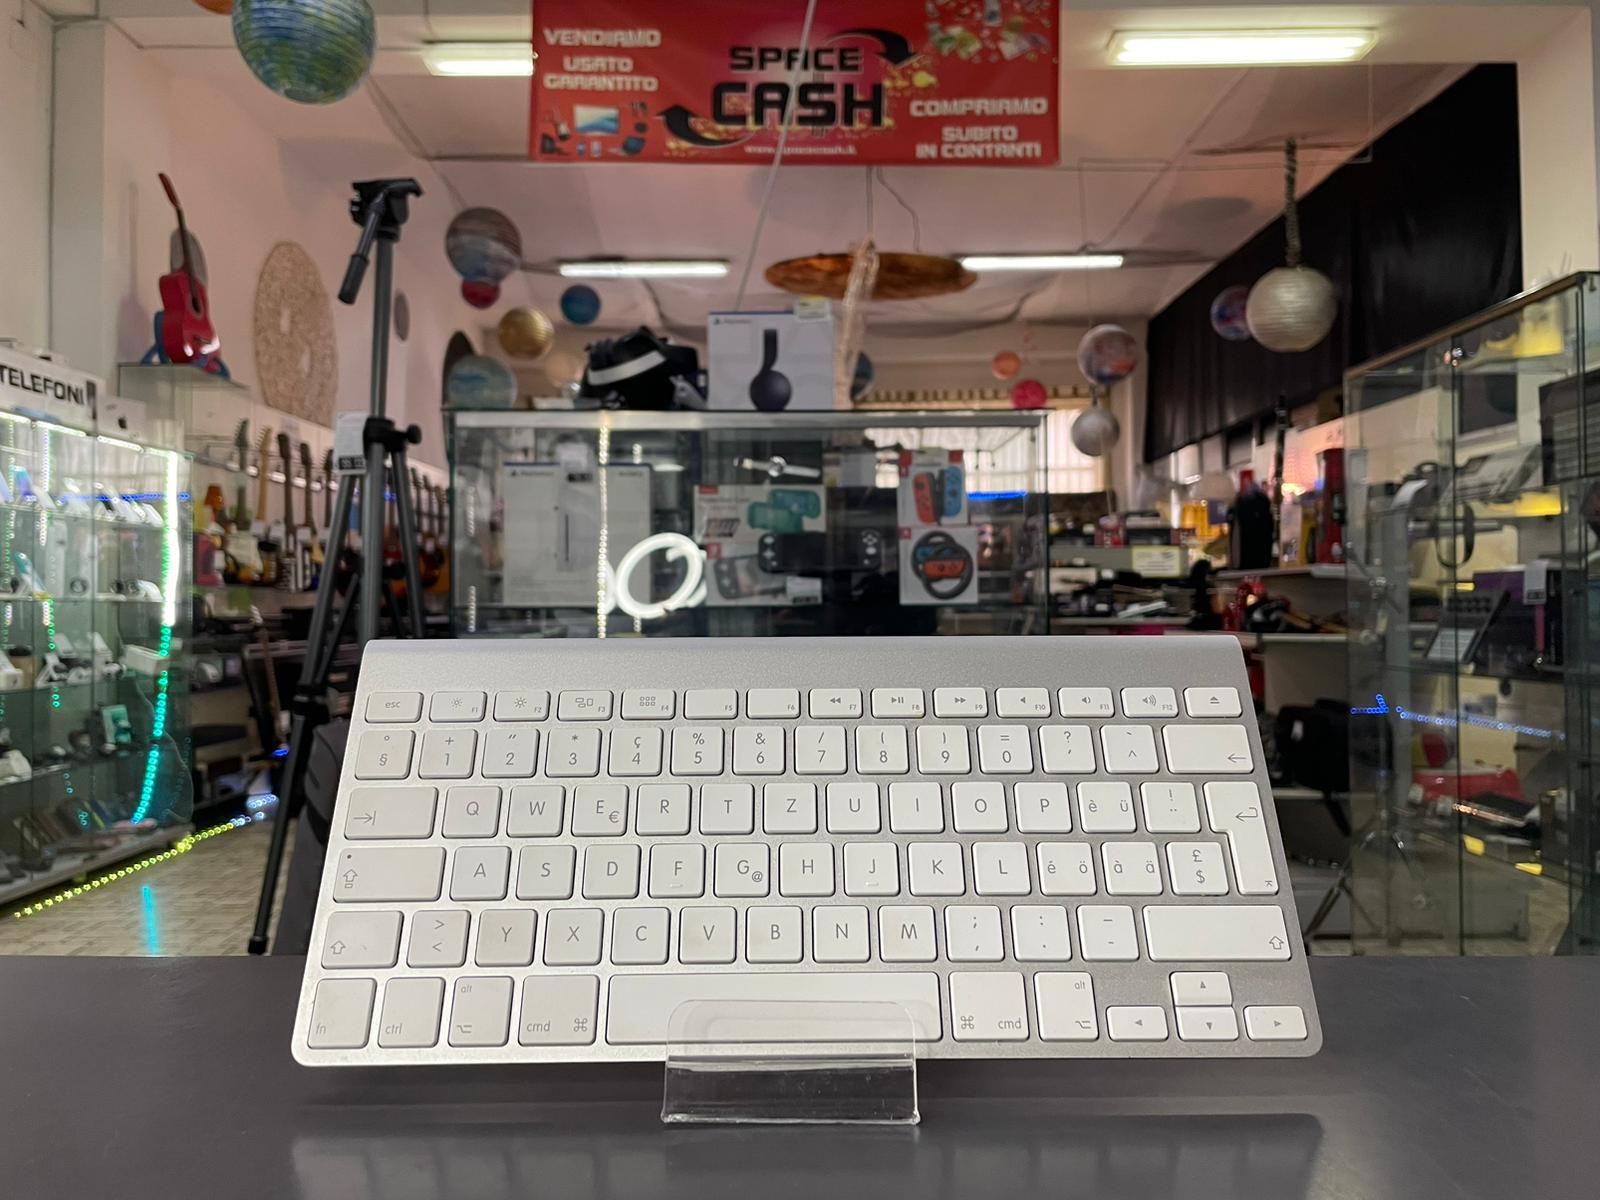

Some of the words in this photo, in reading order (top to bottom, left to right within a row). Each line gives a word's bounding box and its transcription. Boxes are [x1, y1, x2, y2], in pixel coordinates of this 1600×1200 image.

[543, 27, 662, 48] VENDIAMO
[563, 55, 634, 73] USATO
[729, 46, 863, 72] SPACE
[543, 73, 659, 92] GARANTITO
[712, 81, 884, 128] CASH
[909, 97, 1049, 117] COMPRIAMO
[941, 125, 1018, 142] SUBITO
[915, 143, 938, 159] IN
[940, 142, 1042, 158] CONTANTI
[0, 363, 86, 405] TELEFONI
[445, 737, 454, 745] +
[634, 736, 641, 749] ç
[692, 733, 705, 745] %
[755, 732, 766, 745] &
[818, 732, 824, 743] /
[881, 732, 884, 744] (
[942, 732, 946, 744] )
[1064, 731, 1071, 743] ?
[379, 753, 388, 766] §
[445, 753, 450, 766] 1
[506, 752, 514, 765] 2
[568, 752, 577, 765] 3
[632, 752, 640, 765] 4
[694, 751, 702, 764] 5
[756, 751, 765, 764] 6
[818, 750, 826, 763] 7
[879, 750, 888, 763] 8
[941, 750, 950, 763] 9
[1002, 750, 1011, 763] 0
[1169, 789, 1173, 801] !
[466, 801, 479, 816] Q
[529, 801, 546, 816] W
[596, 800, 604, 814] E
[660, 799, 669, 814] R
[724, 800, 733, 814] T
[787, 798, 797, 813] Z
[849, 798, 860, 813] U
[916, 798, 919, 812] I
[974, 798, 987, 813] O
[1040, 798, 1050, 813] P
[1088, 799, 1097, 813] è
[1120, 800, 1129, 812] ü
[609, 810, 620, 823] €
[1192, 849, 1203, 862] £
[473, 863, 486, 878] A
[541, 862, 551, 877] S
[607, 861, 618, 876] D
[674, 861, 683, 876] F
[737, 860, 749, 875] G
[802, 859, 814, 874] H
[869, 858, 876, 874] J
[932, 859, 944, 874] K
[998, 859, 1008, 874] L
[1079, 861, 1088, 874] ö
[1113, 860, 1123, 874] à
[1145, 860, 1155, 874] ä
[751, 871, 763, 883] @
[1196, 869, 1205, 884] $
[434, 920, 445, 930] >
[771, 924, 781, 940] B
[836, 923, 848, 939] N
[901, 923, 917, 939] M
[502, 927, 512, 942] Y
[567, 926, 580, 942] X
[635, 925, 647, 941] C
[703, 925, 715, 941] V
[432, 942, 442, 952] <
[461, 984, 472, 993] alt
[1074, 980, 1085, 990] alt
[316, 1022, 326, 1035] fn
[385, 1023, 403, 1035] ctrl
[526, 1020, 551, 1032] cmd
[998, 1017, 1022, 1029] cmd
